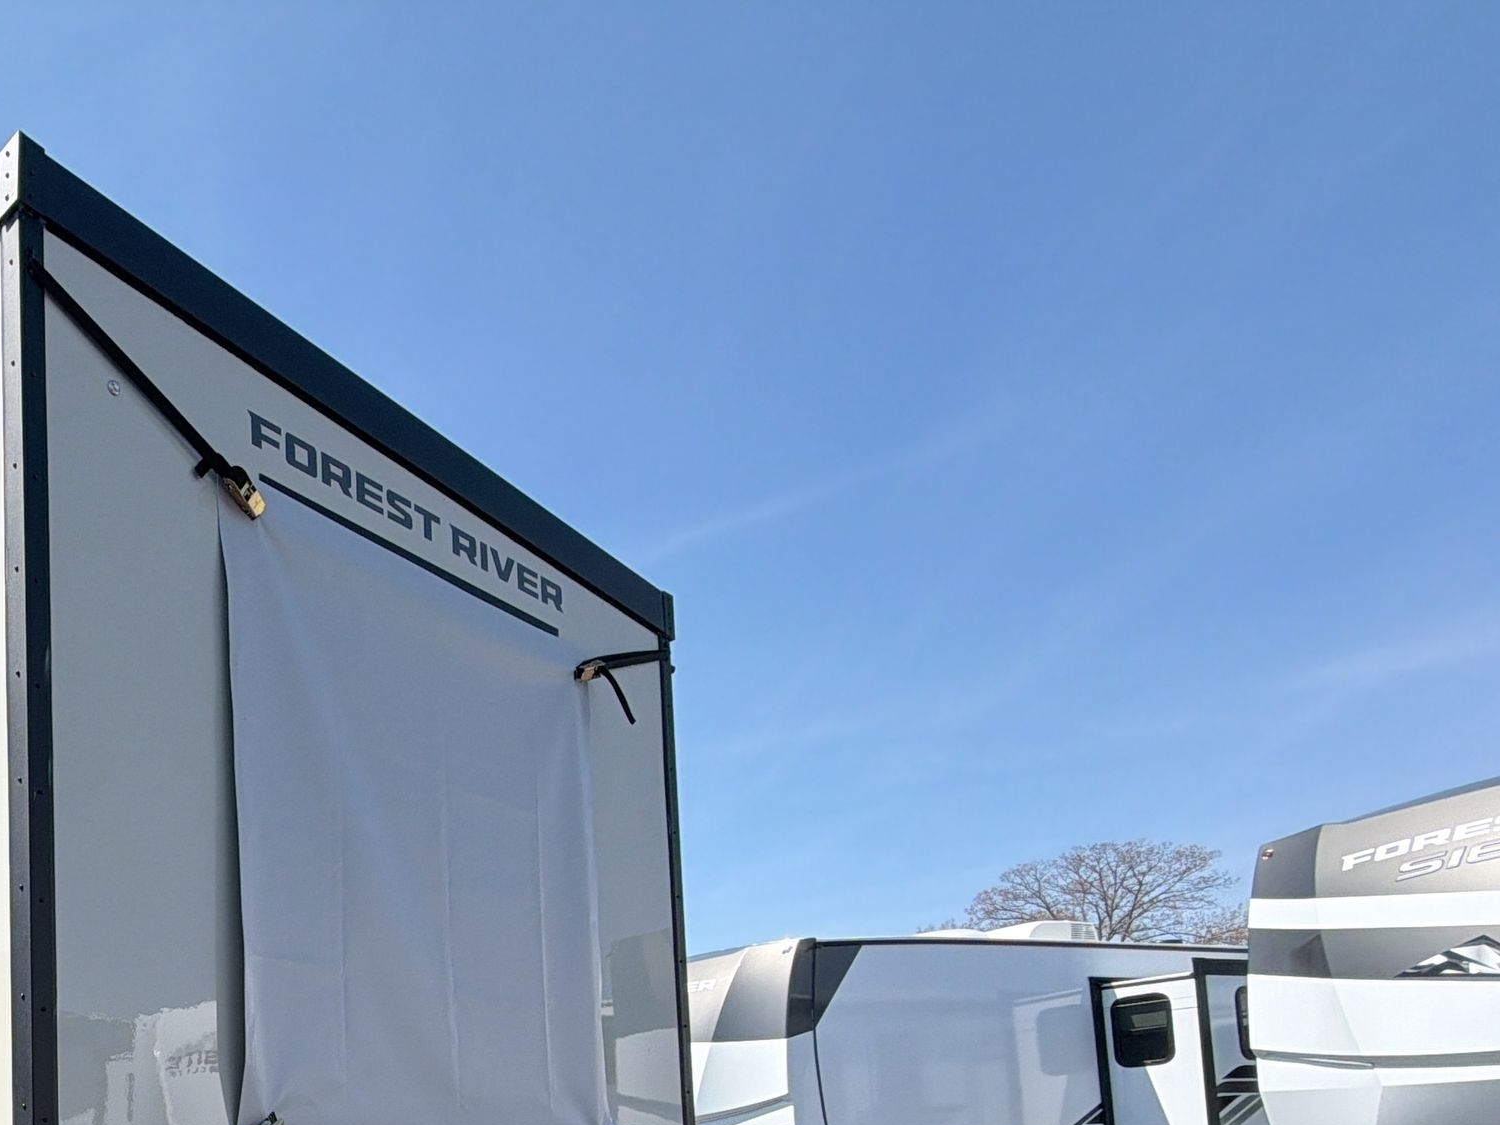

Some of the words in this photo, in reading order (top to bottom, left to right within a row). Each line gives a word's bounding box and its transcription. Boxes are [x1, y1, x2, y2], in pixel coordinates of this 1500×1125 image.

[247, 408, 441, 542] FOREST
[449, 522, 564, 614] RIVER
[1342, 815, 1500, 872] FORE
